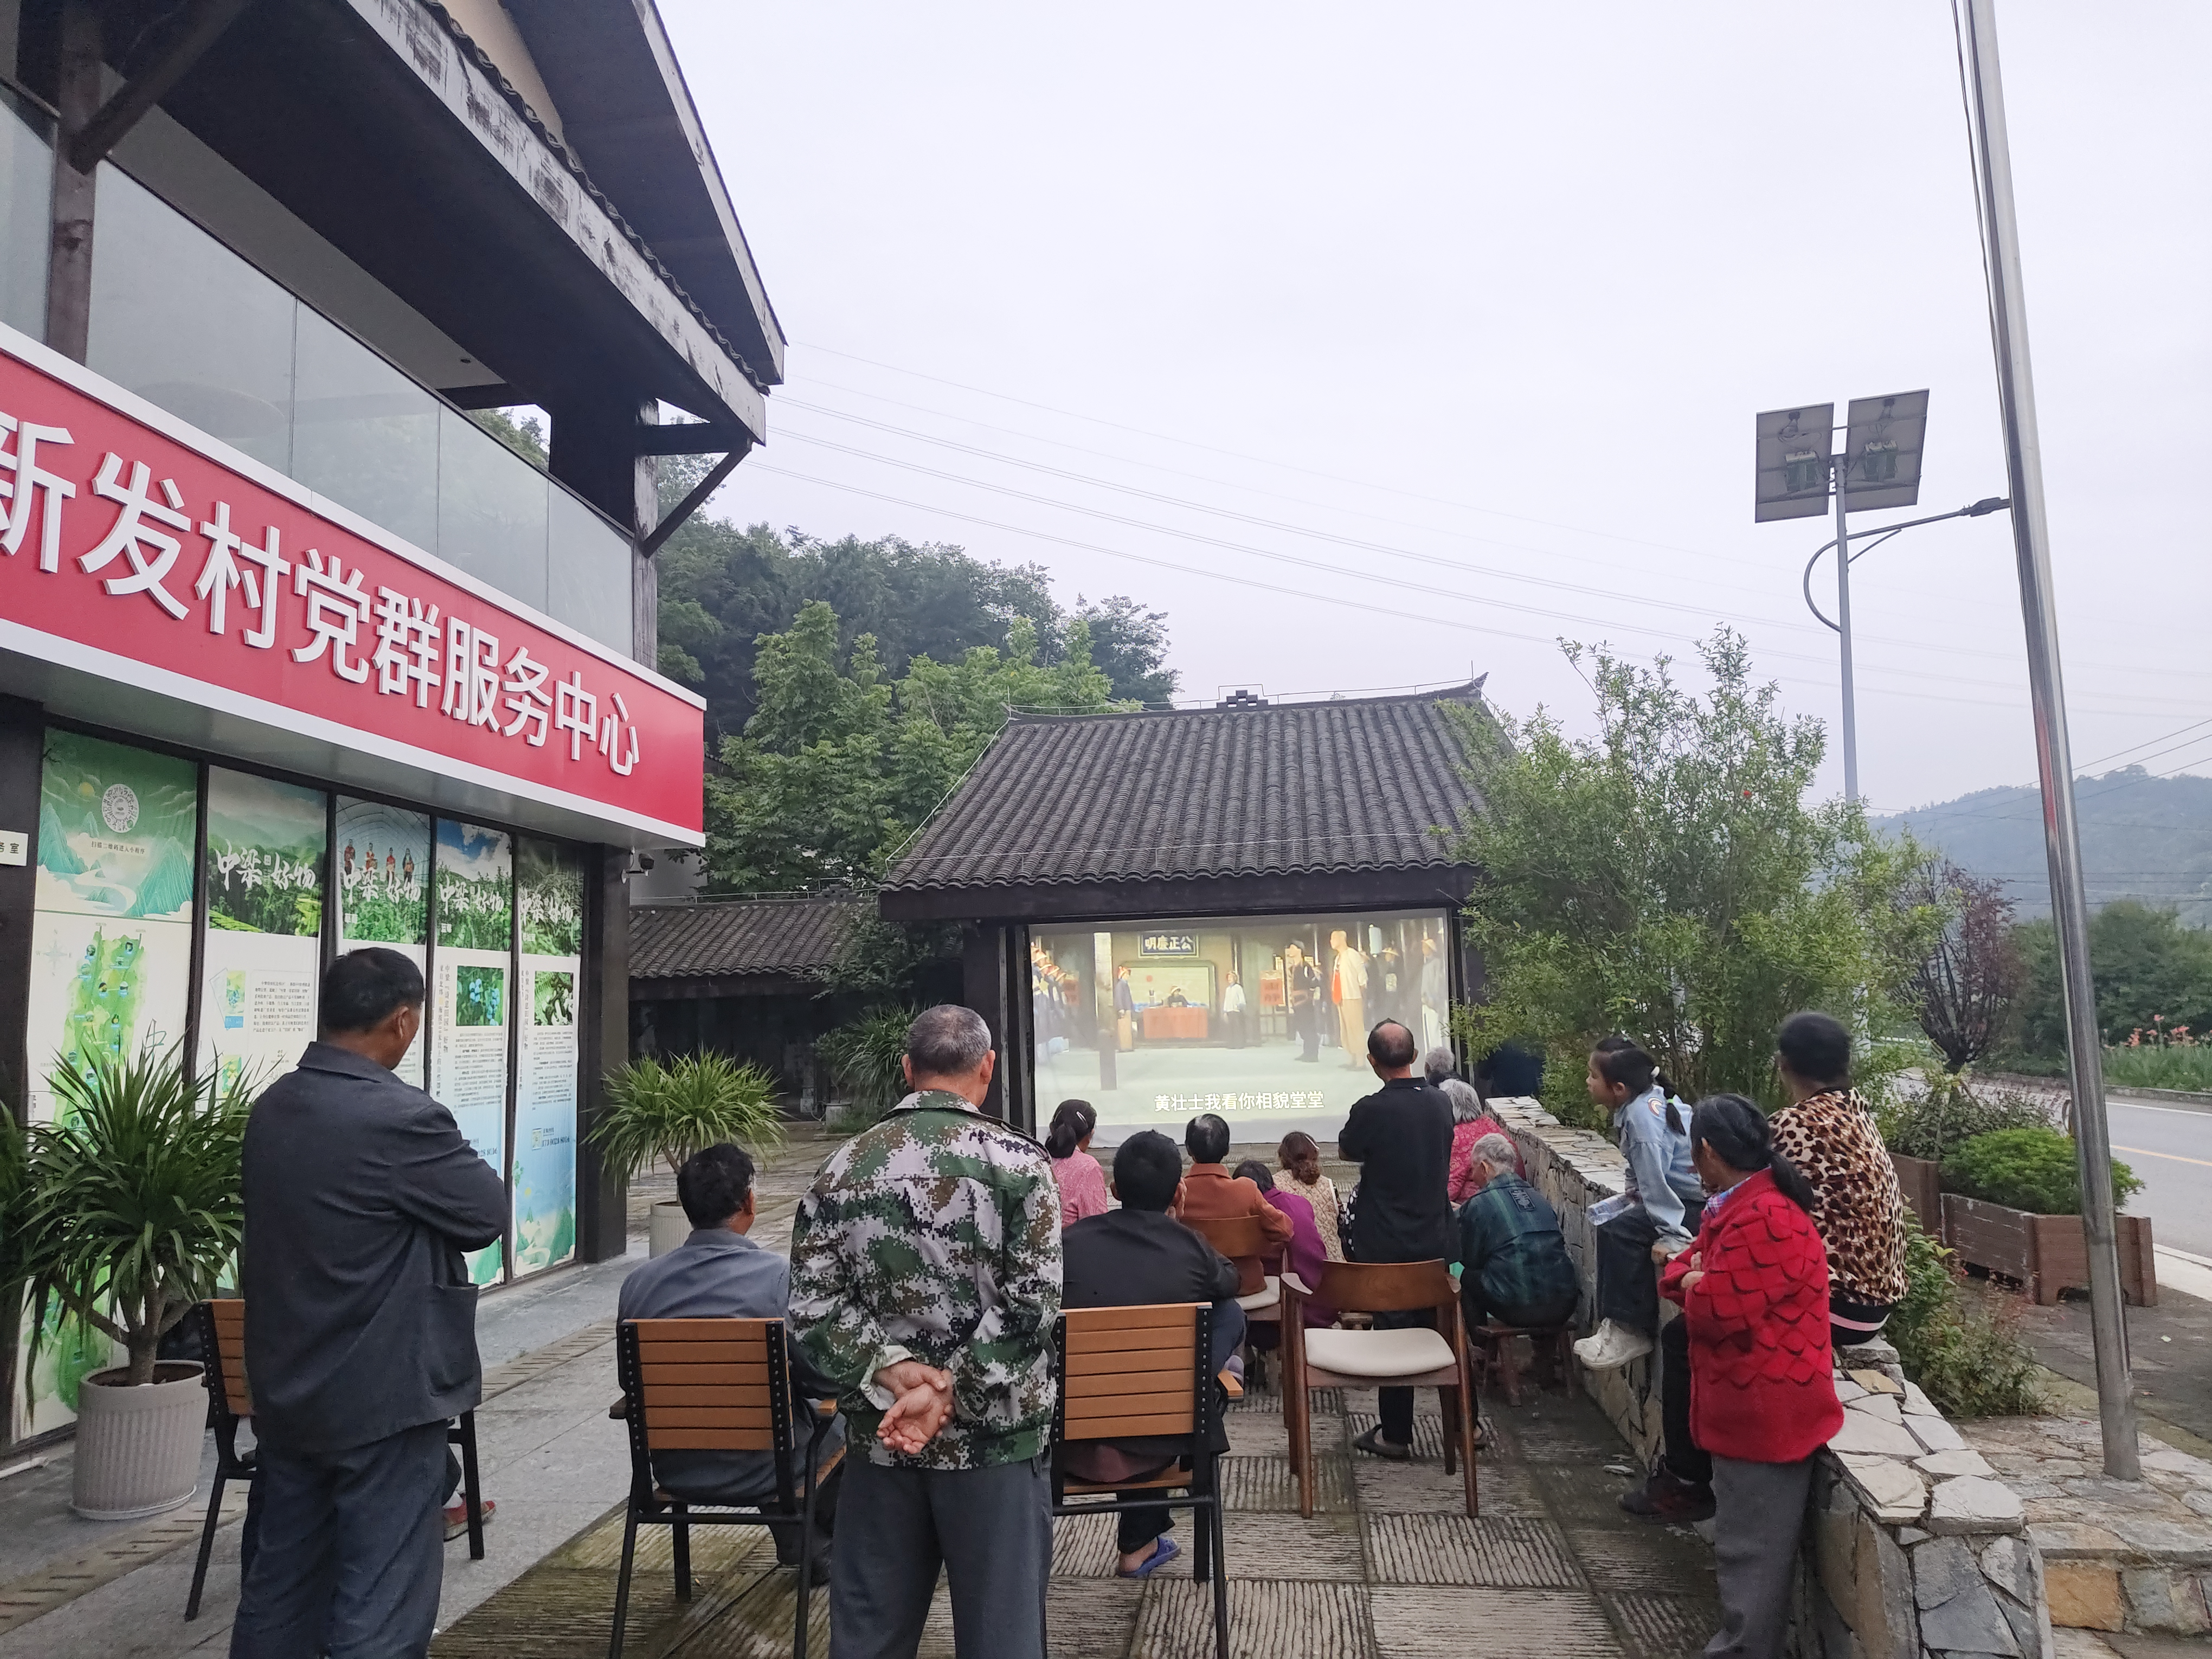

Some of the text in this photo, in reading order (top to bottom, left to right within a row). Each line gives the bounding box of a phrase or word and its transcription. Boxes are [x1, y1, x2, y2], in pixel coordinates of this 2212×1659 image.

[0, 411, 639, 776] 新发村党群服务中心
[91, 841, 145, 854] 扫描二维码进入小程序
[1154, 1090, 1324, 1112] 黄壮士我看你相貌堂堂
